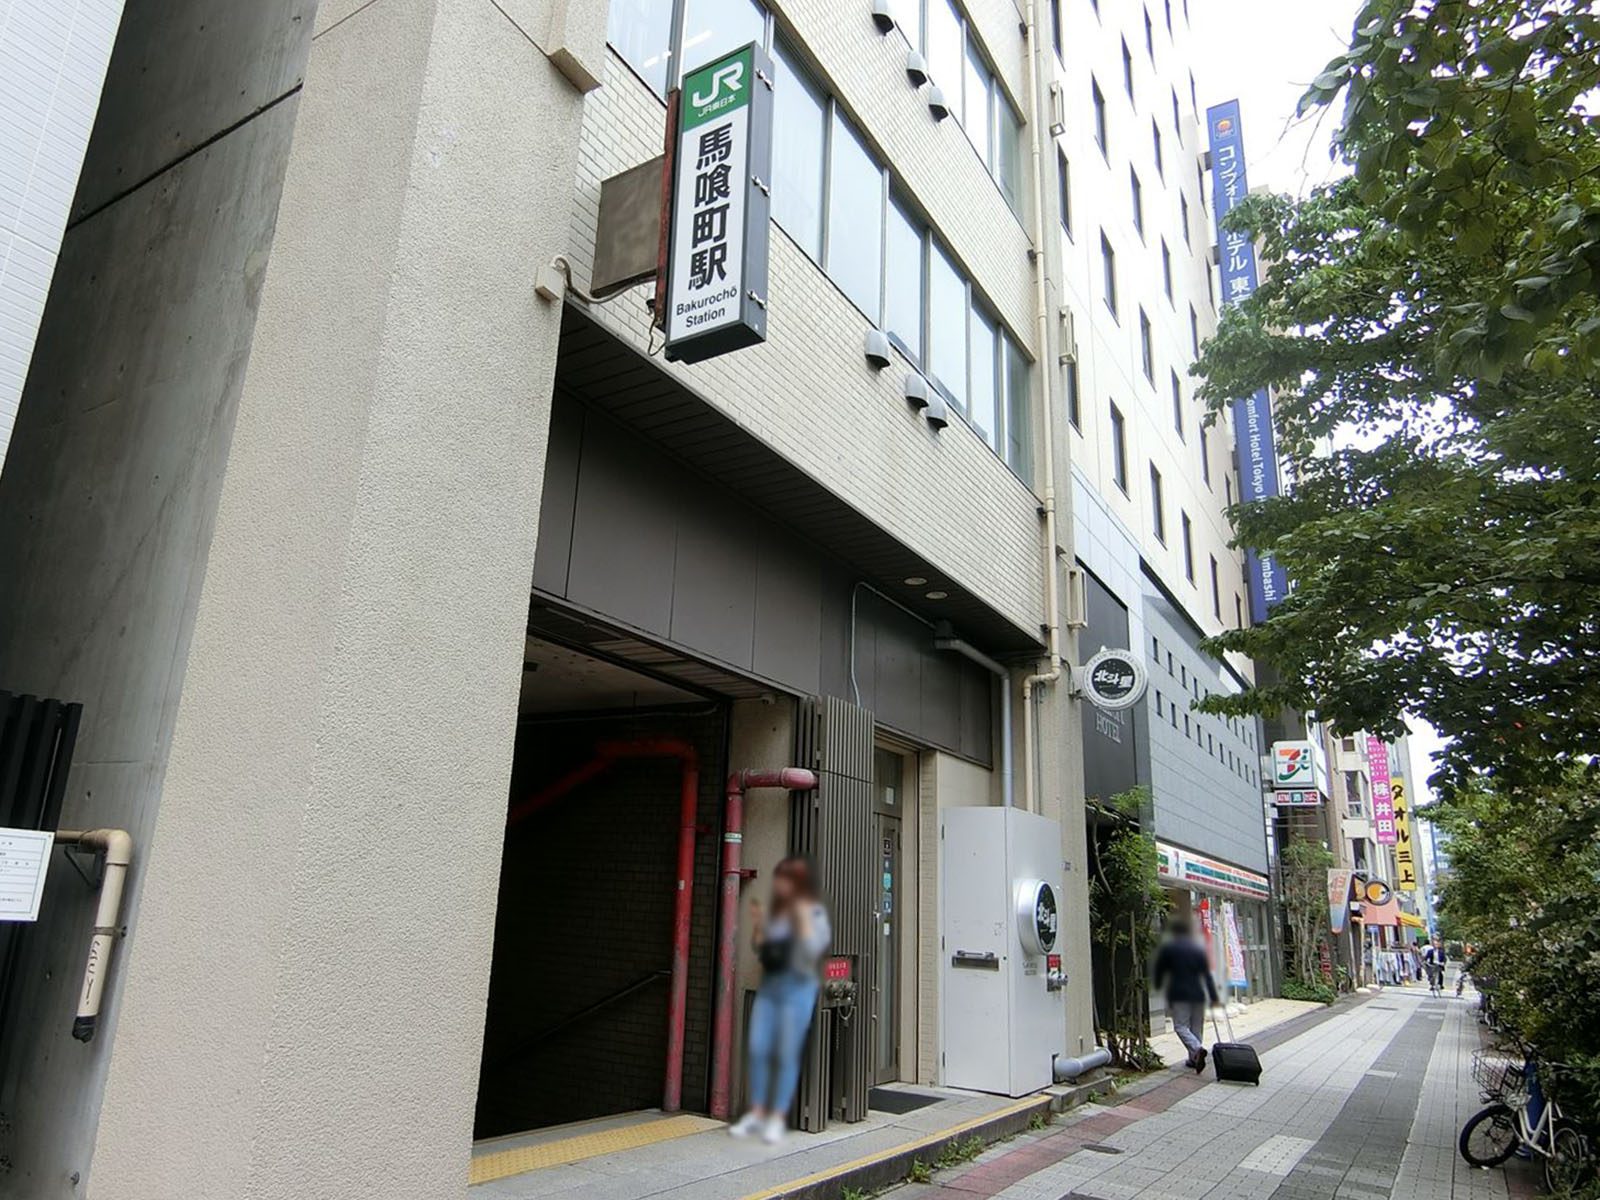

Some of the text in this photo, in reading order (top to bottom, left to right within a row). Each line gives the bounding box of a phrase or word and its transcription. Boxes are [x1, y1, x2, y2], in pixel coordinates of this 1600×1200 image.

[692, 61, 744, 107] JR
[697, 94, 737, 117] JR東日本
[688, 122, 733, 291] 馬喰町駅
[685, 307, 726, 328] Station
[1249, 433, 1265, 461] Hotel
[1251, 462, 1266, 493] Tokyo
